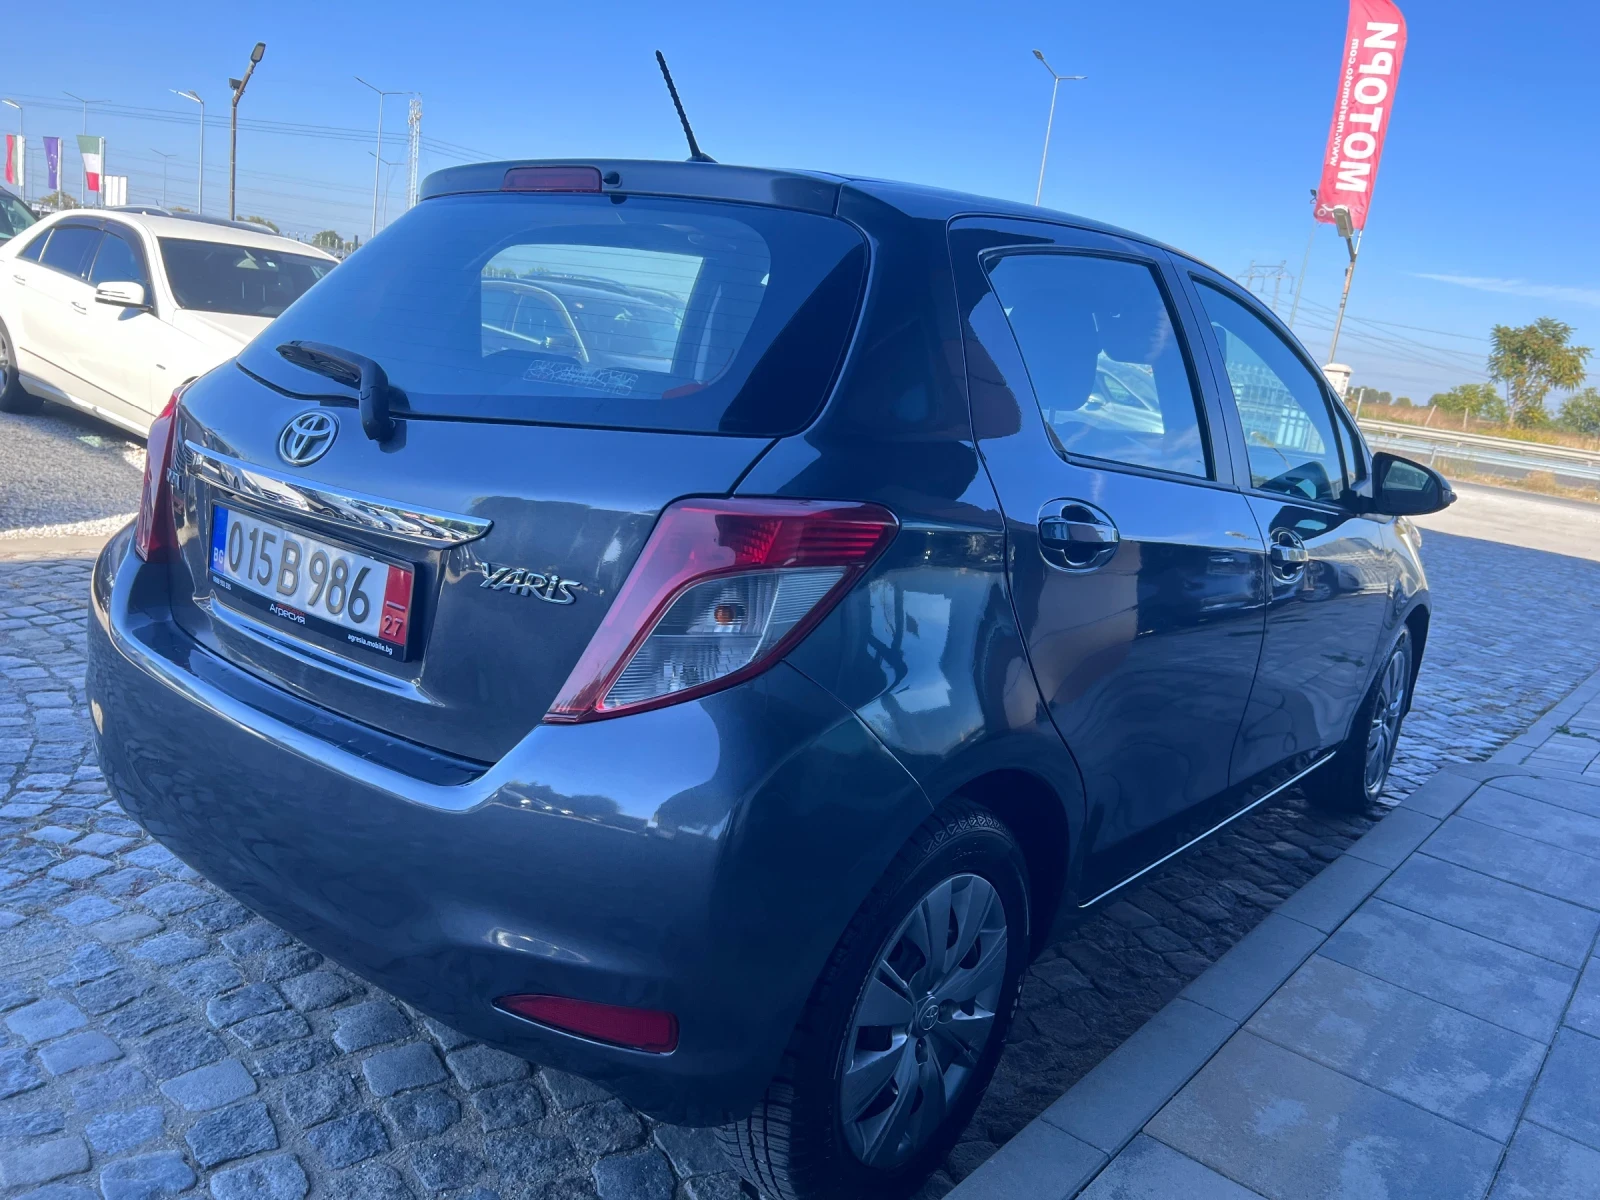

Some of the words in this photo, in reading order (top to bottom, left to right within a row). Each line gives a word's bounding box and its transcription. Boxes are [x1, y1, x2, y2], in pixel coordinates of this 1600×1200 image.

[213, 546, 224, 565] BG
[269, 603, 306, 625] Агресия
[383, 614, 404, 637] 27
[347, 633, 393, 656] agresia.mobile.bg
